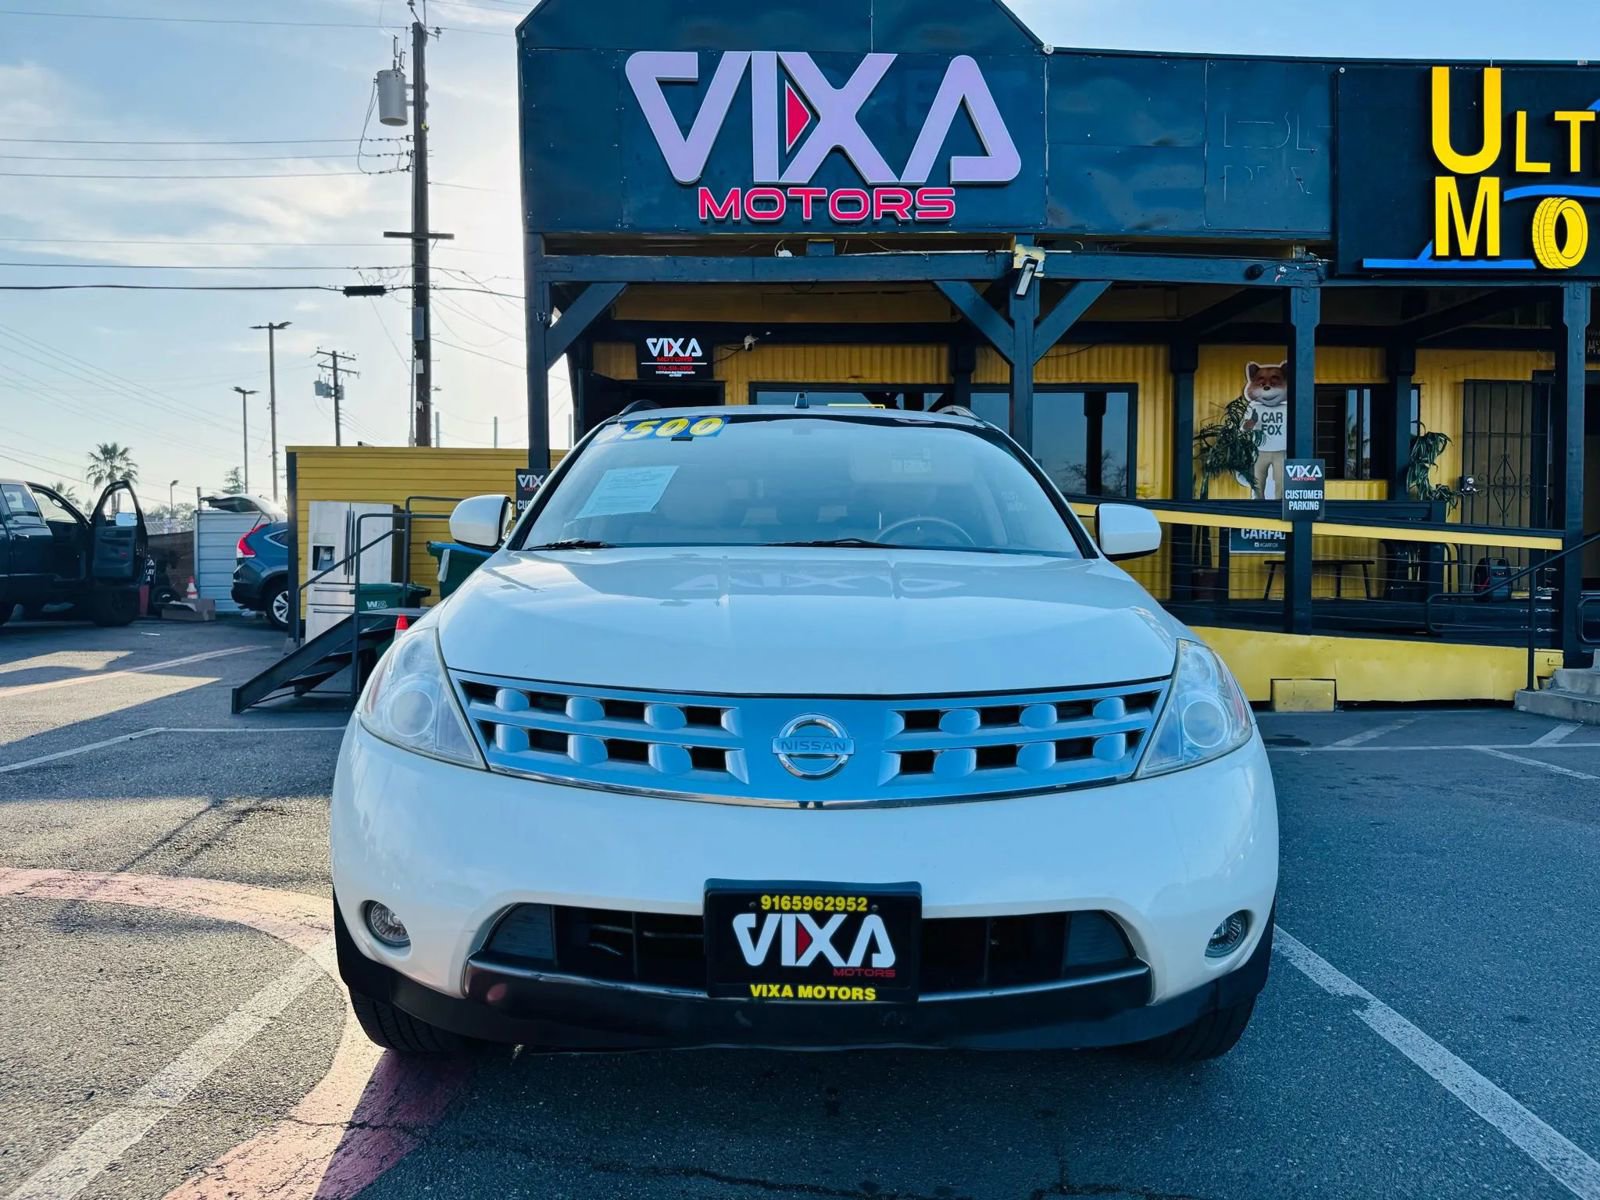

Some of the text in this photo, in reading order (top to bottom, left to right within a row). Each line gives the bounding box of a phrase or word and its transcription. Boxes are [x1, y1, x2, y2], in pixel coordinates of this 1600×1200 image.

[625, 51, 1021, 184] VIXA
[698, 187, 956, 221] MOTORS
[645, 337, 703, 357] VIXA
[1261, 412, 1283, 423] CAR
[1261, 424, 1282, 435] FOX
[1285, 465, 1322, 477] VIXA
[517, 474, 545, 488] VIX
[1285, 490, 1323, 499] CUSTOMER
[1288, 501, 1319, 510] PARKING
[781, 741, 846, 752] NISSAN
[760, 895, 868, 911] 9165962952
[732, 913, 896, 968] VIXA
[833, 967, 896, 978] MOTORS
[750, 984, 876, 1001] VIXA MOTORS
